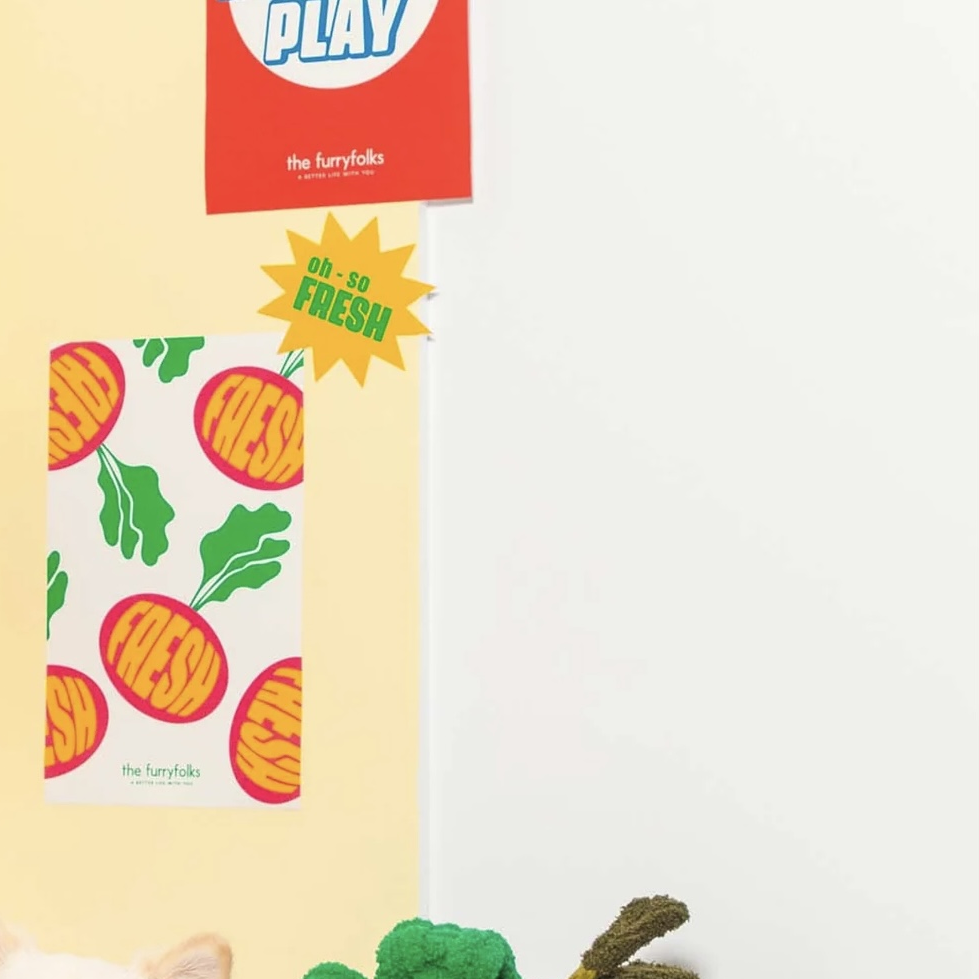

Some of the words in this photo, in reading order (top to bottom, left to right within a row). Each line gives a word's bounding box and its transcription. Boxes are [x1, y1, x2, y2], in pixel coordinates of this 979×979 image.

[263, 0, 408, 66] PLAY
[286, 153, 311, 171] the
[315, 148, 385, 171] furryfolks
[307, 256, 333, 279] oh
[346, 271, 370, 293] so
[292, 275, 393, 342] FRESH
[107, 600, 221, 717] FRESH
[121, 763, 141, 776] the
[146, 763, 201, 779] furryfolks
